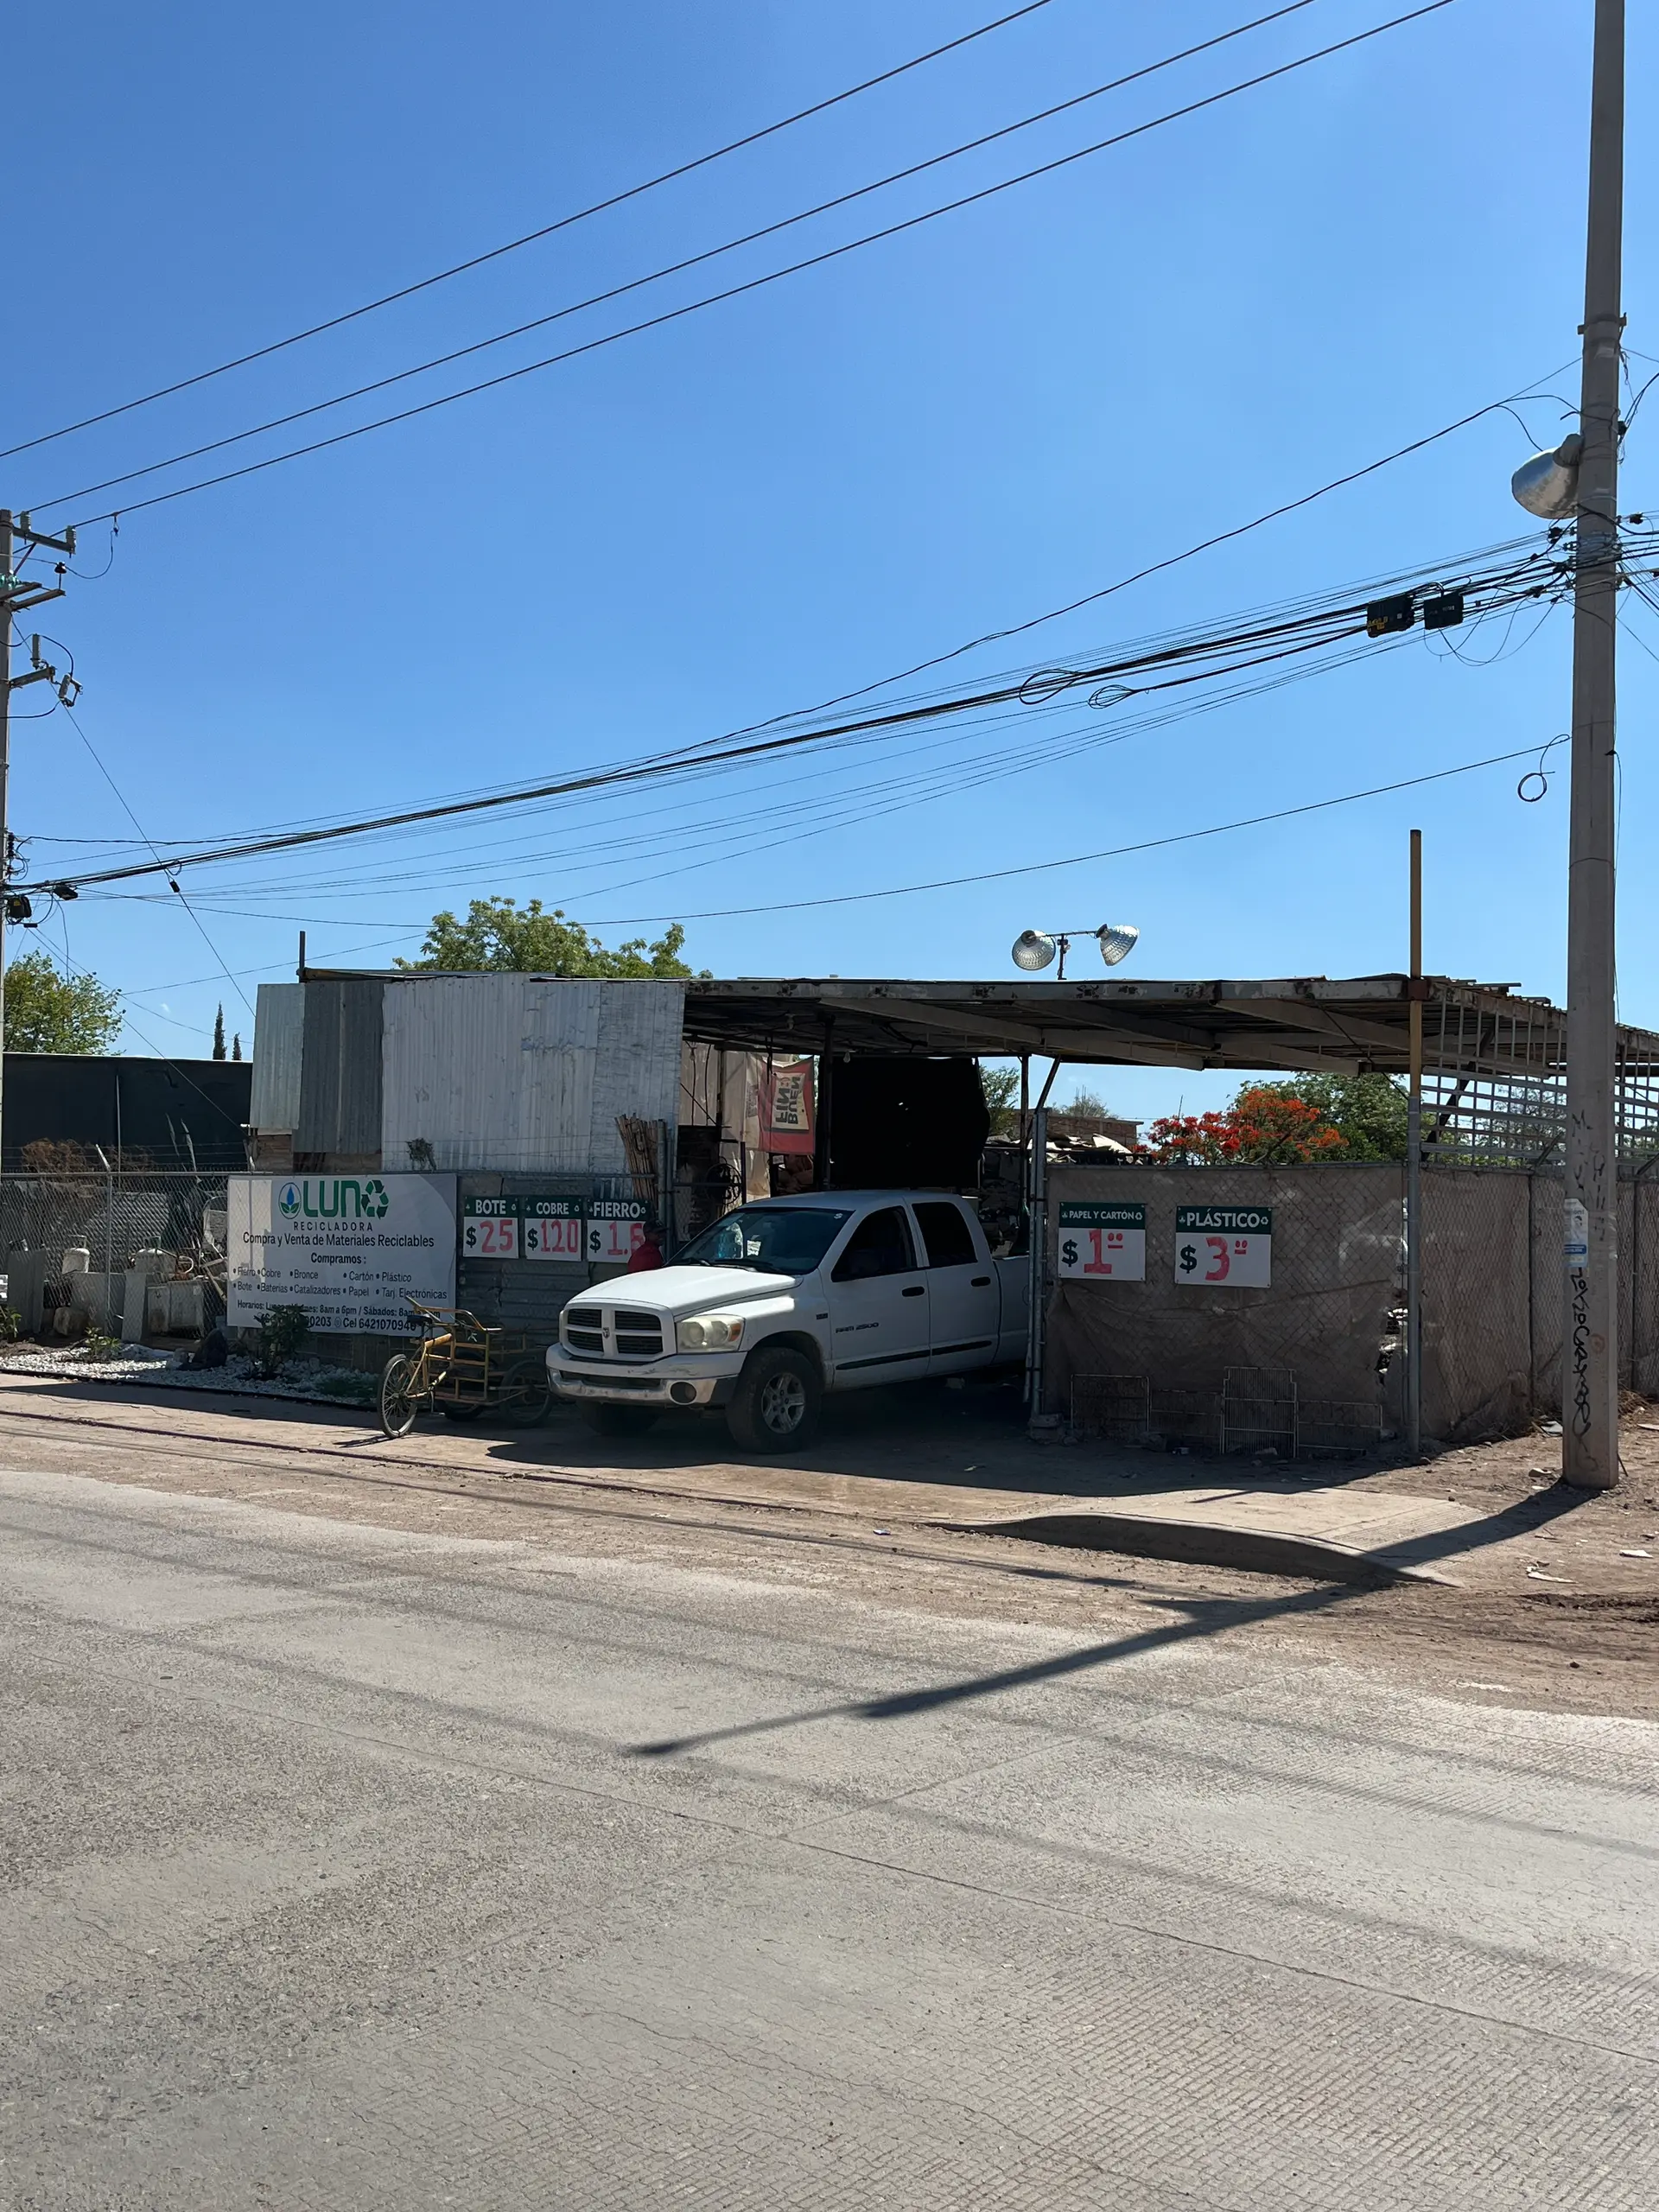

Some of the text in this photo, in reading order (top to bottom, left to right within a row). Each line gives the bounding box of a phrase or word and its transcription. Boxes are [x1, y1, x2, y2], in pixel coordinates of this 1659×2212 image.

[475, 1199, 506, 1215] BOTE
[536, 1202, 569, 1215] COBRE
[593, 1202, 640, 1218] FIERRO
[1069, 1209, 1135, 1221] PAPEL Y CARTÓN
[1186, 1208, 1261, 1228] PLÁSTICO
[293, 1221, 373, 1231] RECICLADORA
[243, 1231, 435, 1248] Compra y Venta de Materiales Reciclables
[311, 1252, 362, 1266] Compramos
[261, 1268, 281, 1278] Cobre
[294, 1269, 318, 1280] Bronce
[348, 1270, 373, 1281] Cartón
[381, 1271, 412, 1282] Plástico
[237, 1281, 252, 1292] Bote
[294, 1284, 340, 1294] Catalizadores
[348, 1287, 369, 1297] Papel
[399, 1287, 447, 1299] Electrónicas
[237, 1300, 264, 1309] Horarios:
[319, 1305, 335, 1313] 8am
[341, 1306, 357, 1316] 6pm
[364, 1306, 397, 1316] Sábados:
[343, 1318, 357, 1328] Cel
